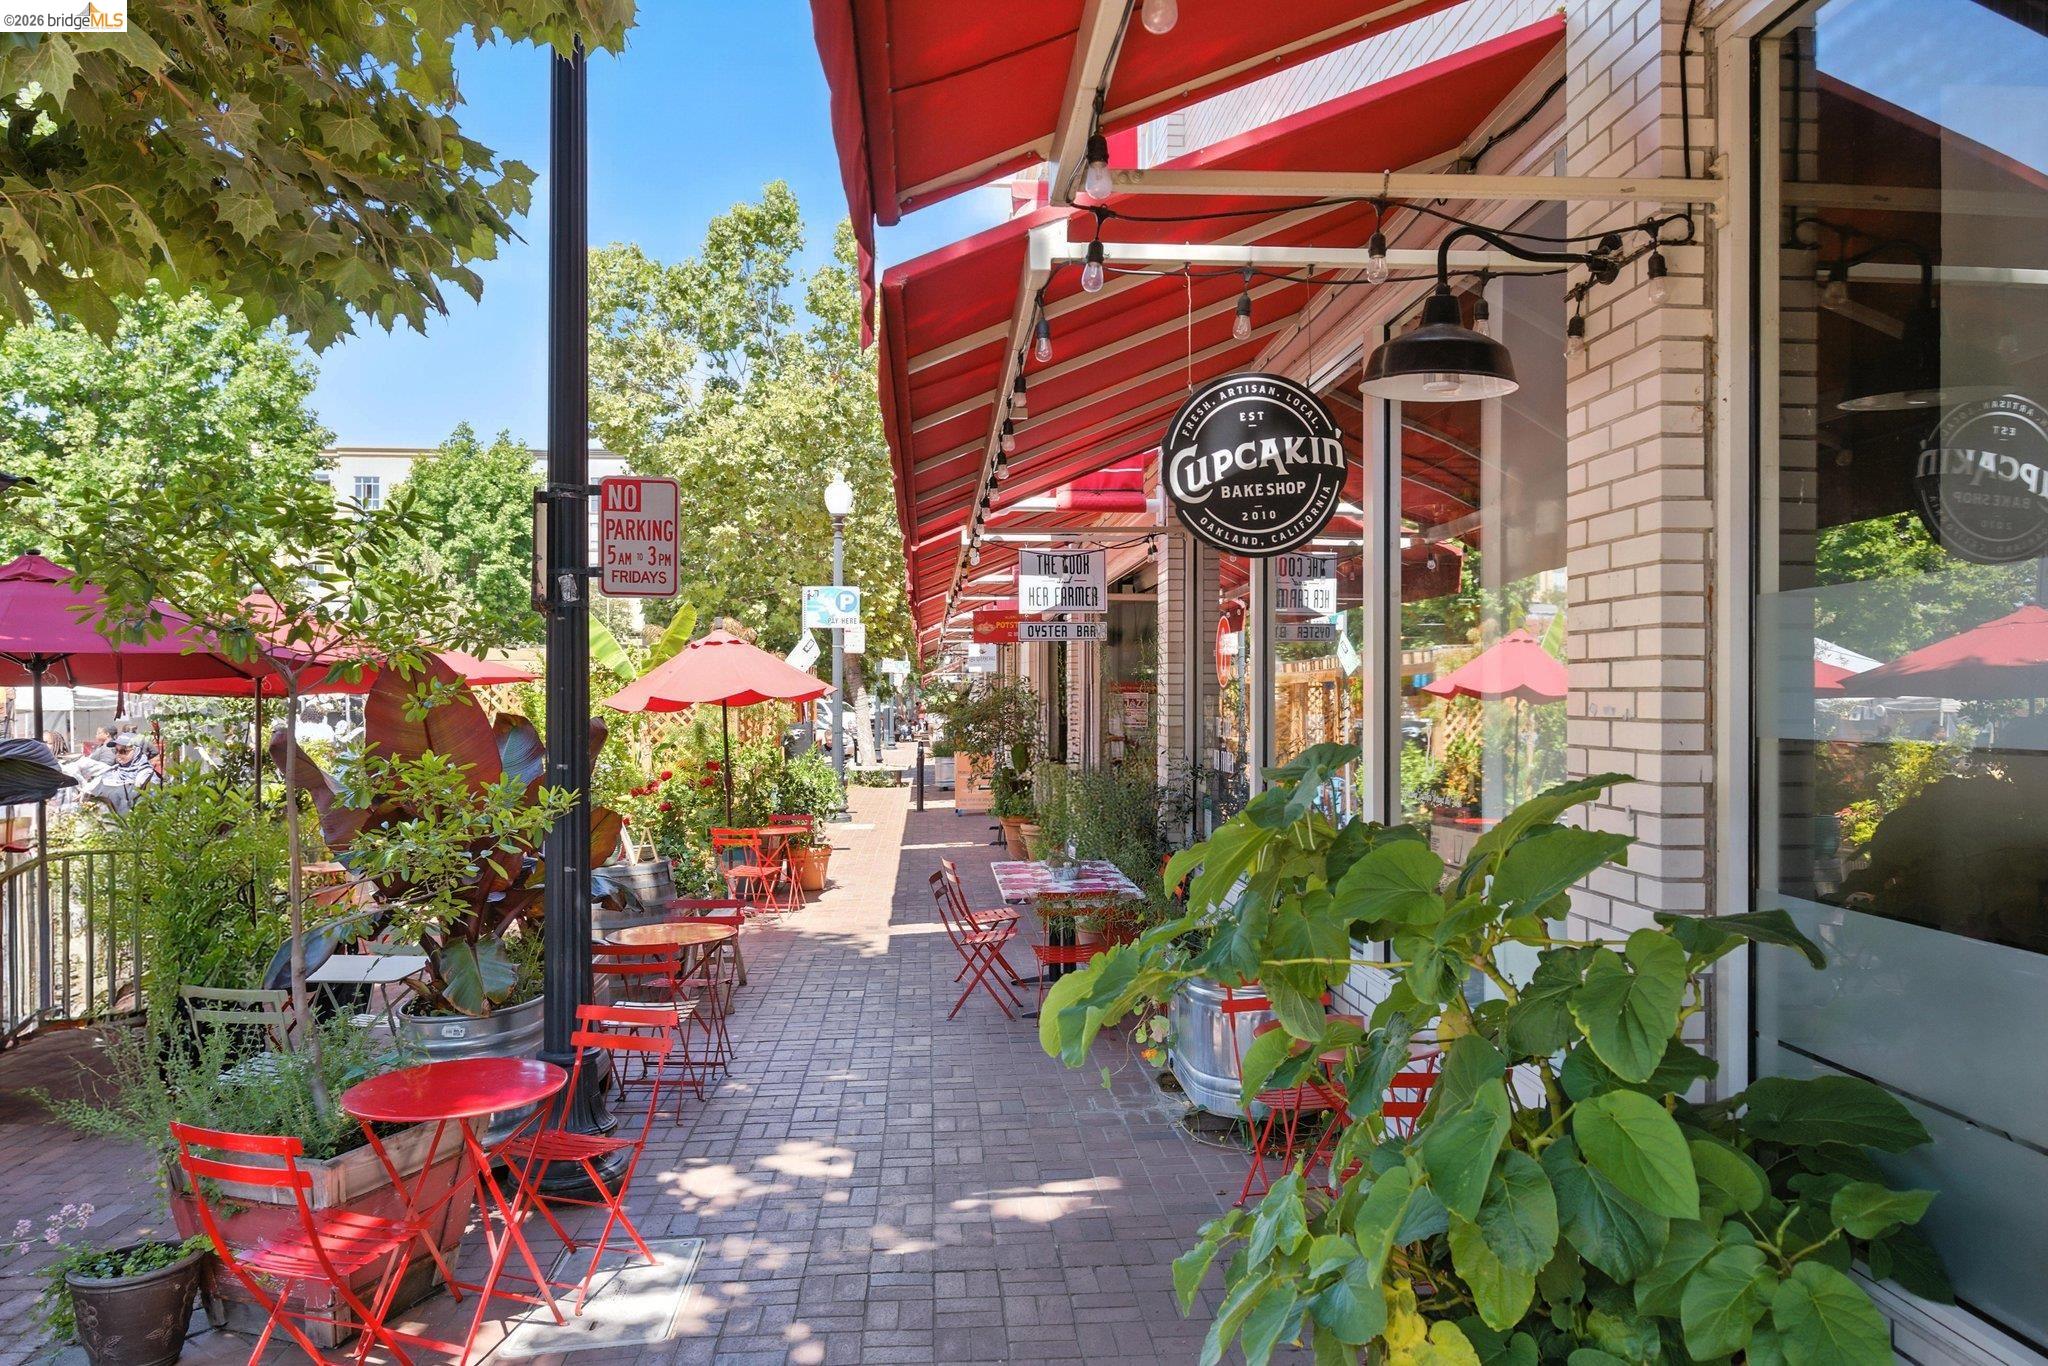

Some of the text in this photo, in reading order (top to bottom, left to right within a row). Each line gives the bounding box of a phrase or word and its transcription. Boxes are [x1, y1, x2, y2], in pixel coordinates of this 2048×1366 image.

[1182, 384, 1319, 437] FRESH. ARTISAN. LOCAL.
[1239, 411, 1265, 422] EST
[608, 484, 638, 510] NO
[1242, 510, 1277, 521] 2010
[1271, 485, 1331, 543] CALIFORNIA
[606, 518, 673, 542] PARKING
[608, 545, 616, 565] 5
[618, 552, 632, 565] AM
[648, 546, 656, 566] 3
[659, 553, 671, 566] PM
[1037, 555, 1057, 575] THE
[611, 570, 667, 584] FRIDAYS
[1028, 586, 1098, 607] HER FARMER
[841, 617, 858, 625] HERE
[1027, 625, 1068, 638] OYSTER
[1076, 625, 1097, 638] BAR
